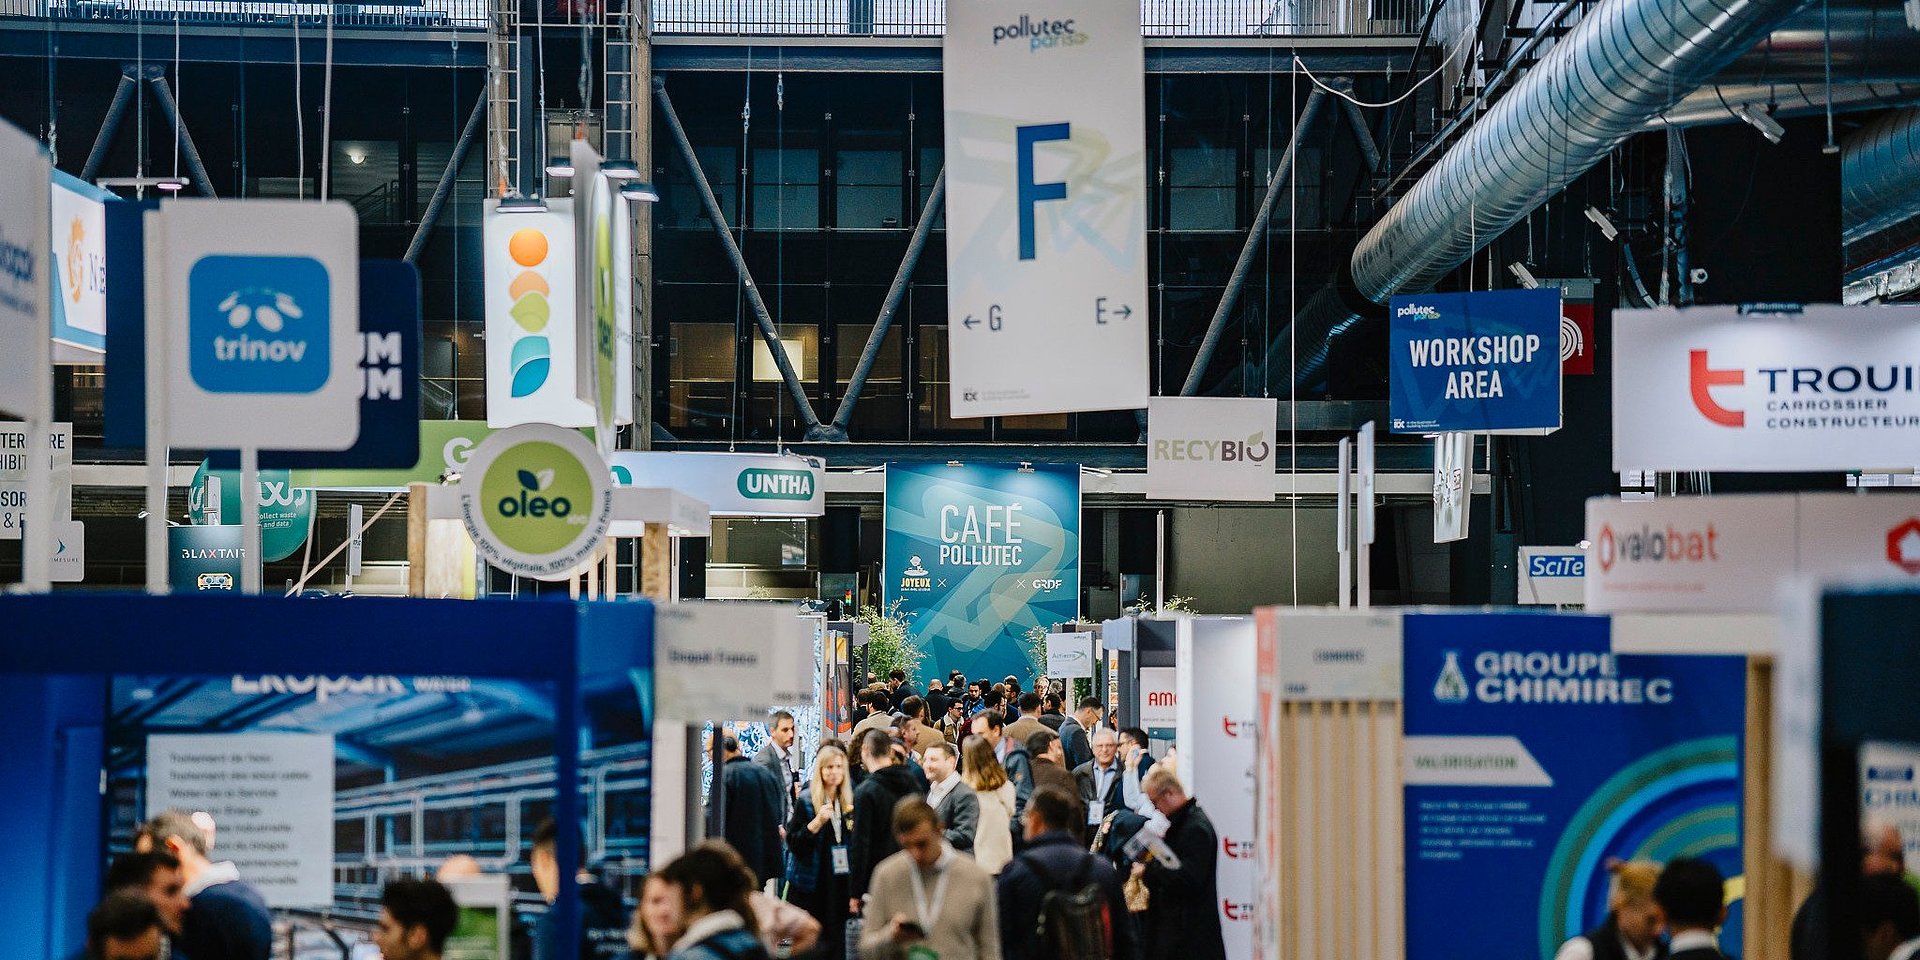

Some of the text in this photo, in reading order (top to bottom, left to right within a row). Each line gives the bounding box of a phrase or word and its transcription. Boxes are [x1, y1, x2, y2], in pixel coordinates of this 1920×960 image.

[993, 13, 1075, 45] pollutec
[1016, 122, 1070, 260] F
[989, 304, 1002, 331] G
[1096, 297, 1107, 325] E
[1398, 303, 1434, 317] pollutec
[214, 334, 306, 362] trinov
[1410, 335, 1540, 367] WORKSHOP
[1445, 370, 1504, 399] AREA
[1759, 365, 1920, 393] TROUI
[1767, 400, 1888, 411] CARROSSIER
[746, 473, 811, 495] UNTHA
[498, 490, 571, 518] oleo
[940, 502, 1023, 544] CAFÉ
[940, 545, 1023, 566] POLLUTEC
[901, 577, 930, 588] JOYEUX
[1032, 579, 1062, 589] GRDF
[1475, 651, 1616, 676] GROUPE
[1475, 677, 1673, 703] CHIMIREC
